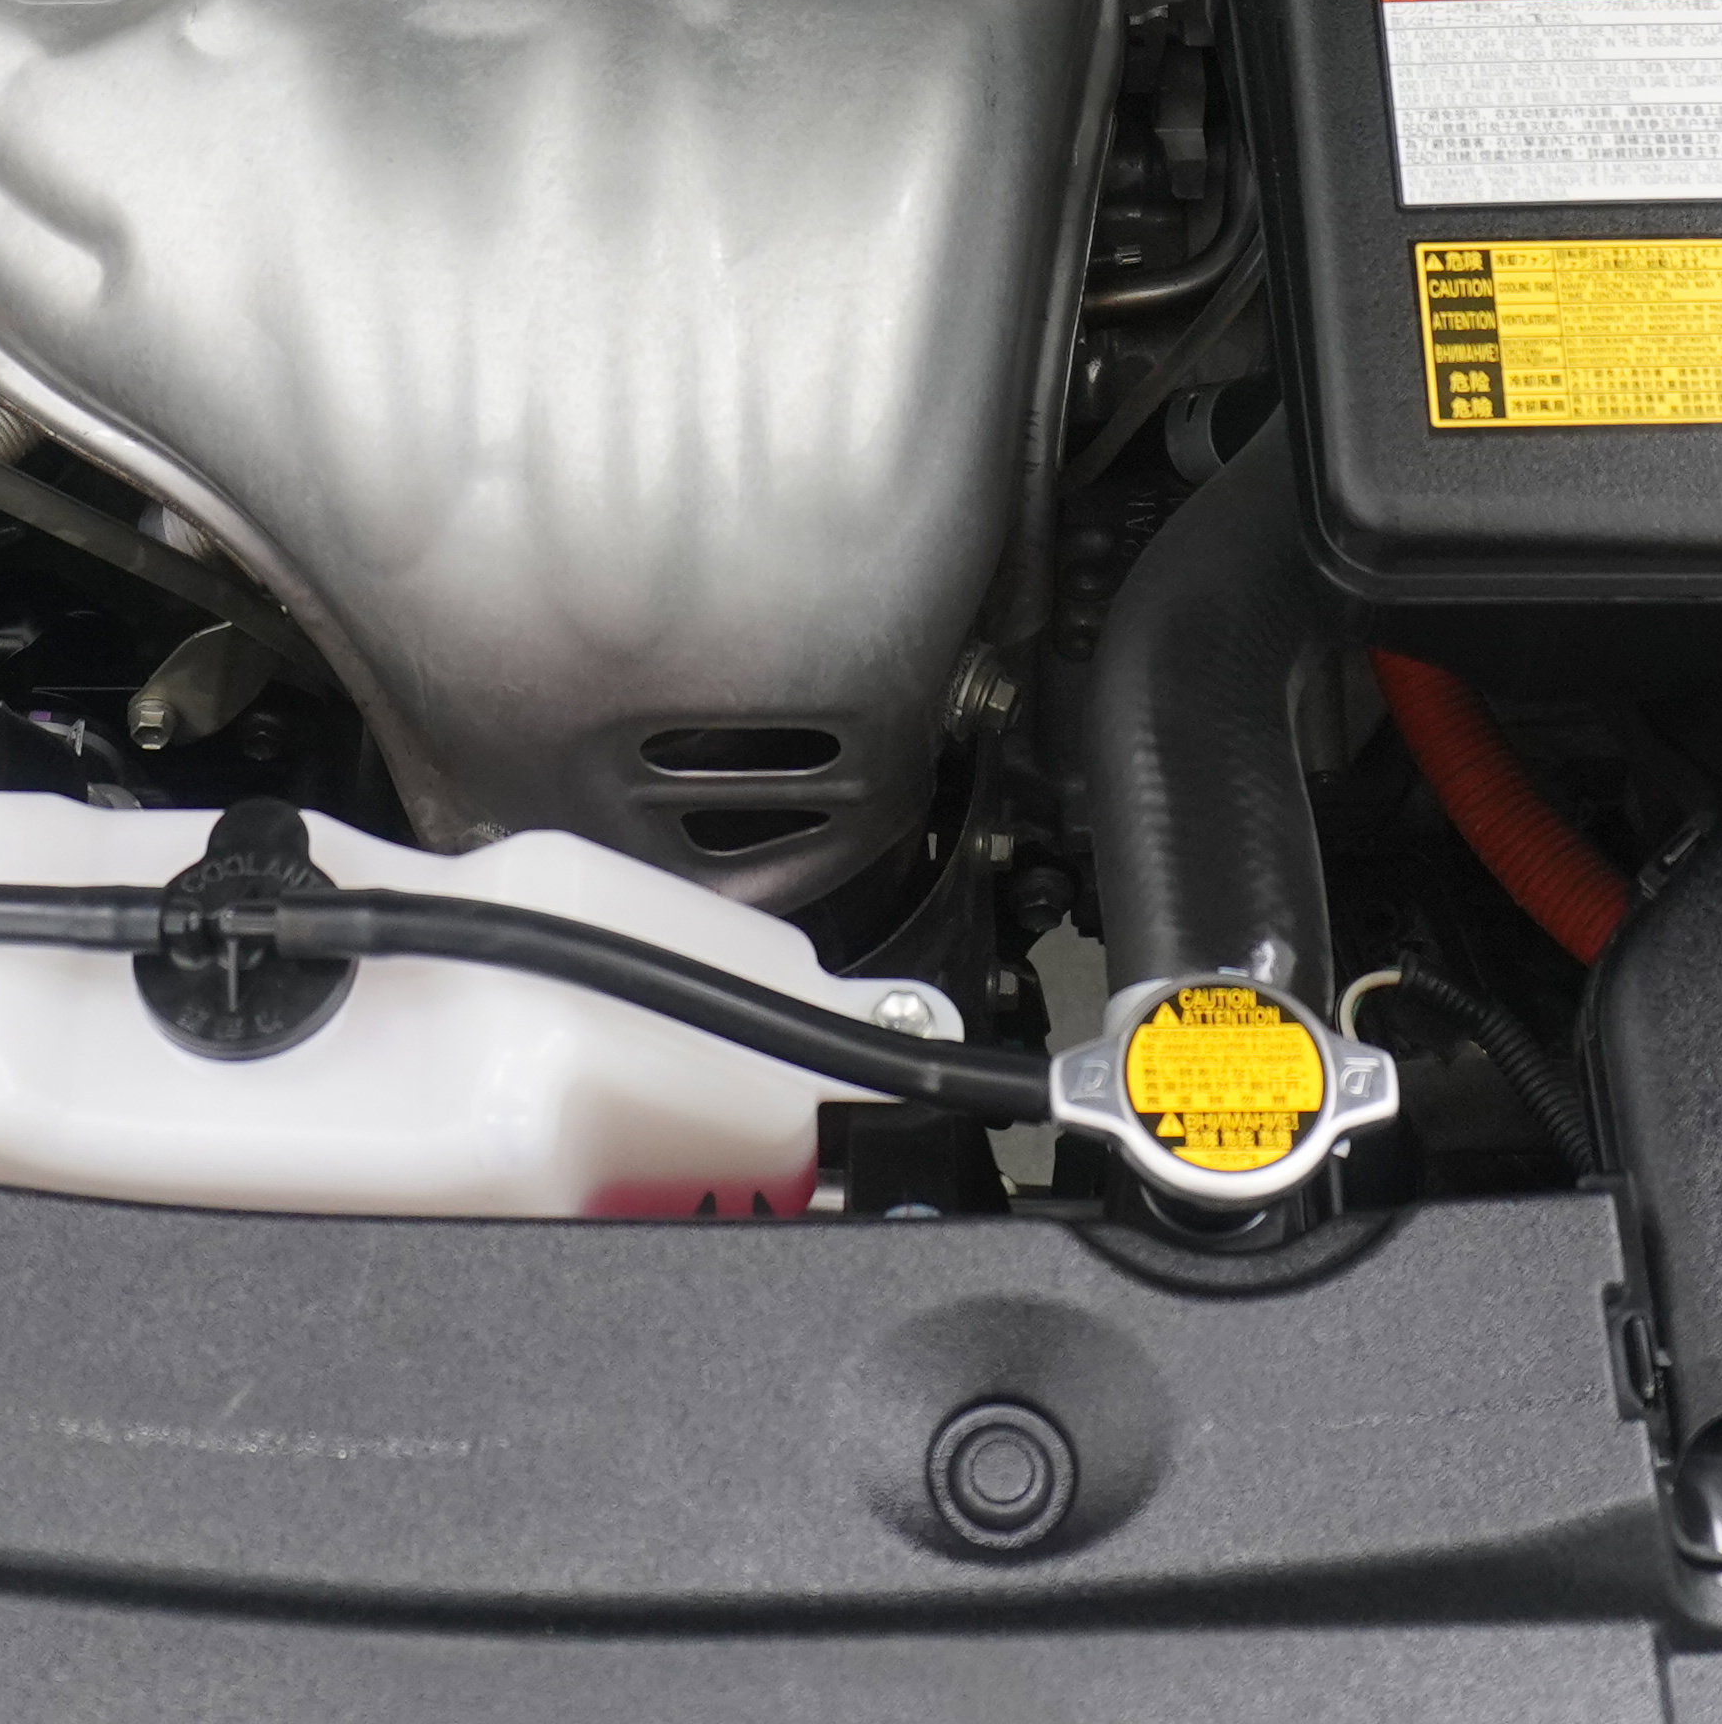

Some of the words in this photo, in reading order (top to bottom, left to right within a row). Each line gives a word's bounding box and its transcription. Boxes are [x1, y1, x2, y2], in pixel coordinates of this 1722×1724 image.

[1428, 277, 1493, 298] CAUTION
[1431, 310, 1496, 331] ATTENTION
[1178, 987, 1257, 1009] CAUTION
[1180, 1006, 1281, 1026] ATTENTION
